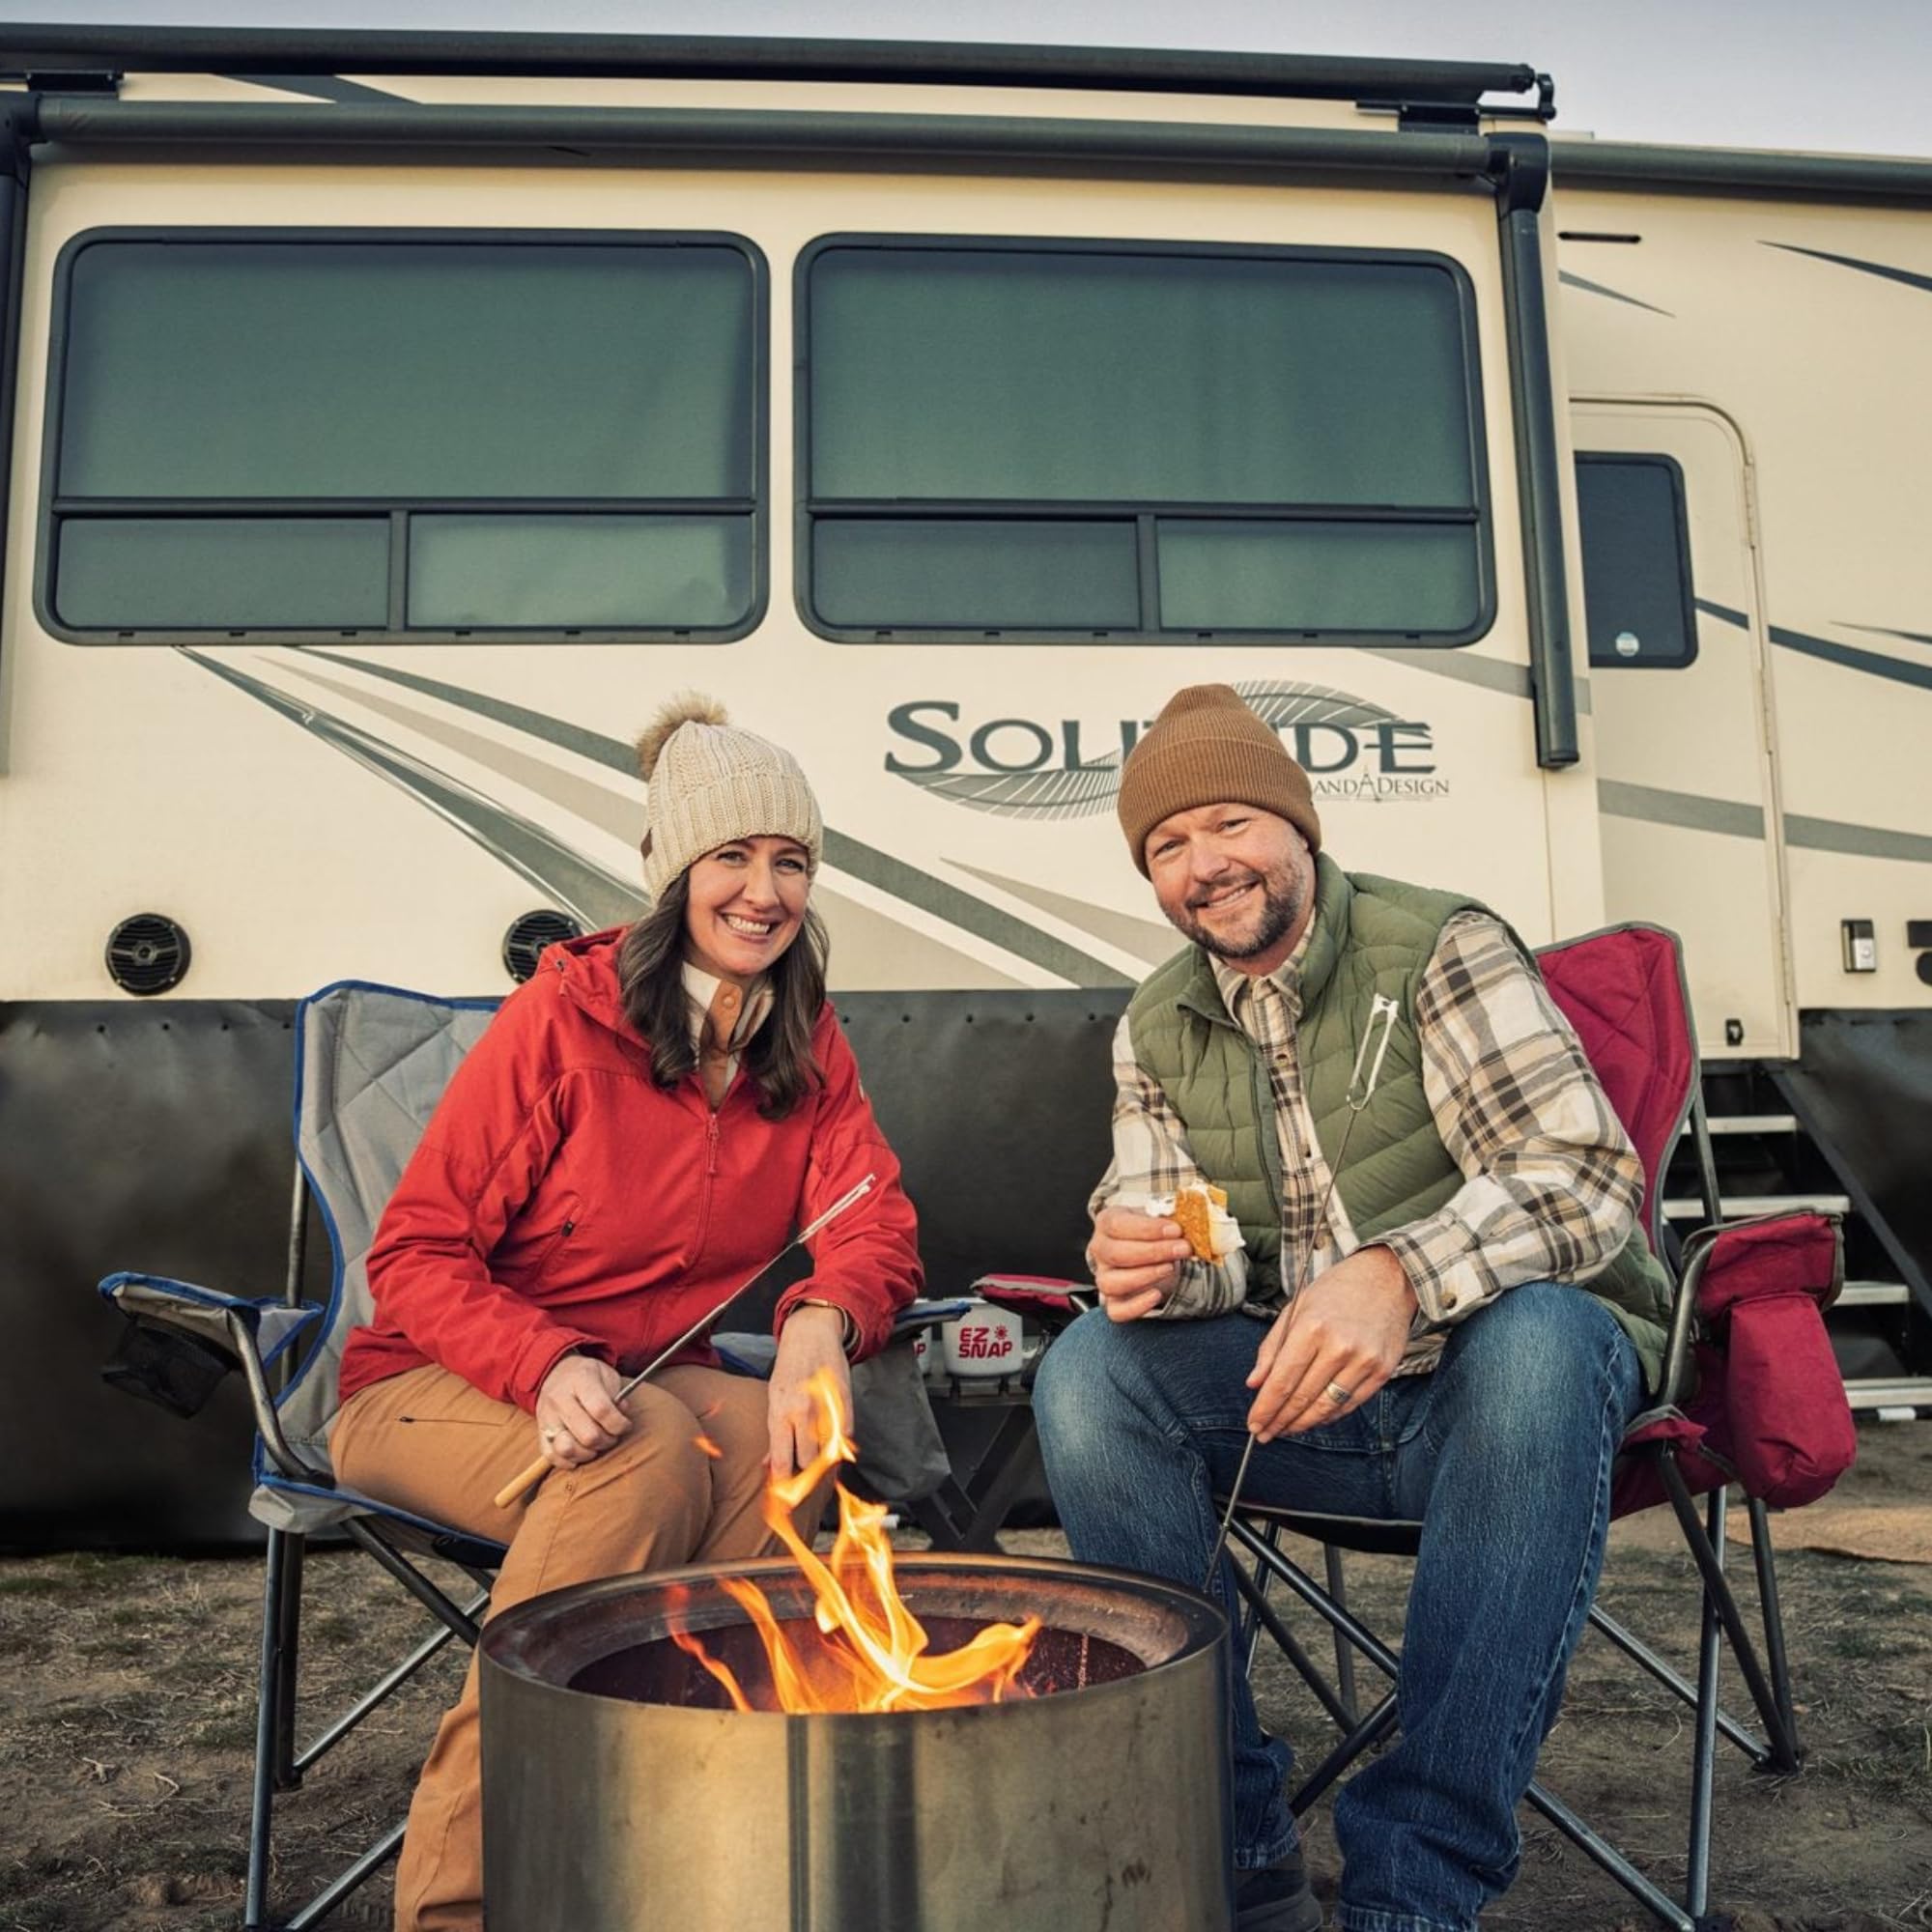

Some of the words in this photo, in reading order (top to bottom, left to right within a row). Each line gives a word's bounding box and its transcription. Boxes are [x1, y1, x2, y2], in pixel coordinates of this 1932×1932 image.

[885, 700, 1436, 774] SOLIDE
[959, 1327, 990, 1343] EZ
[958, 1341, 1013, 1358] SNAP
